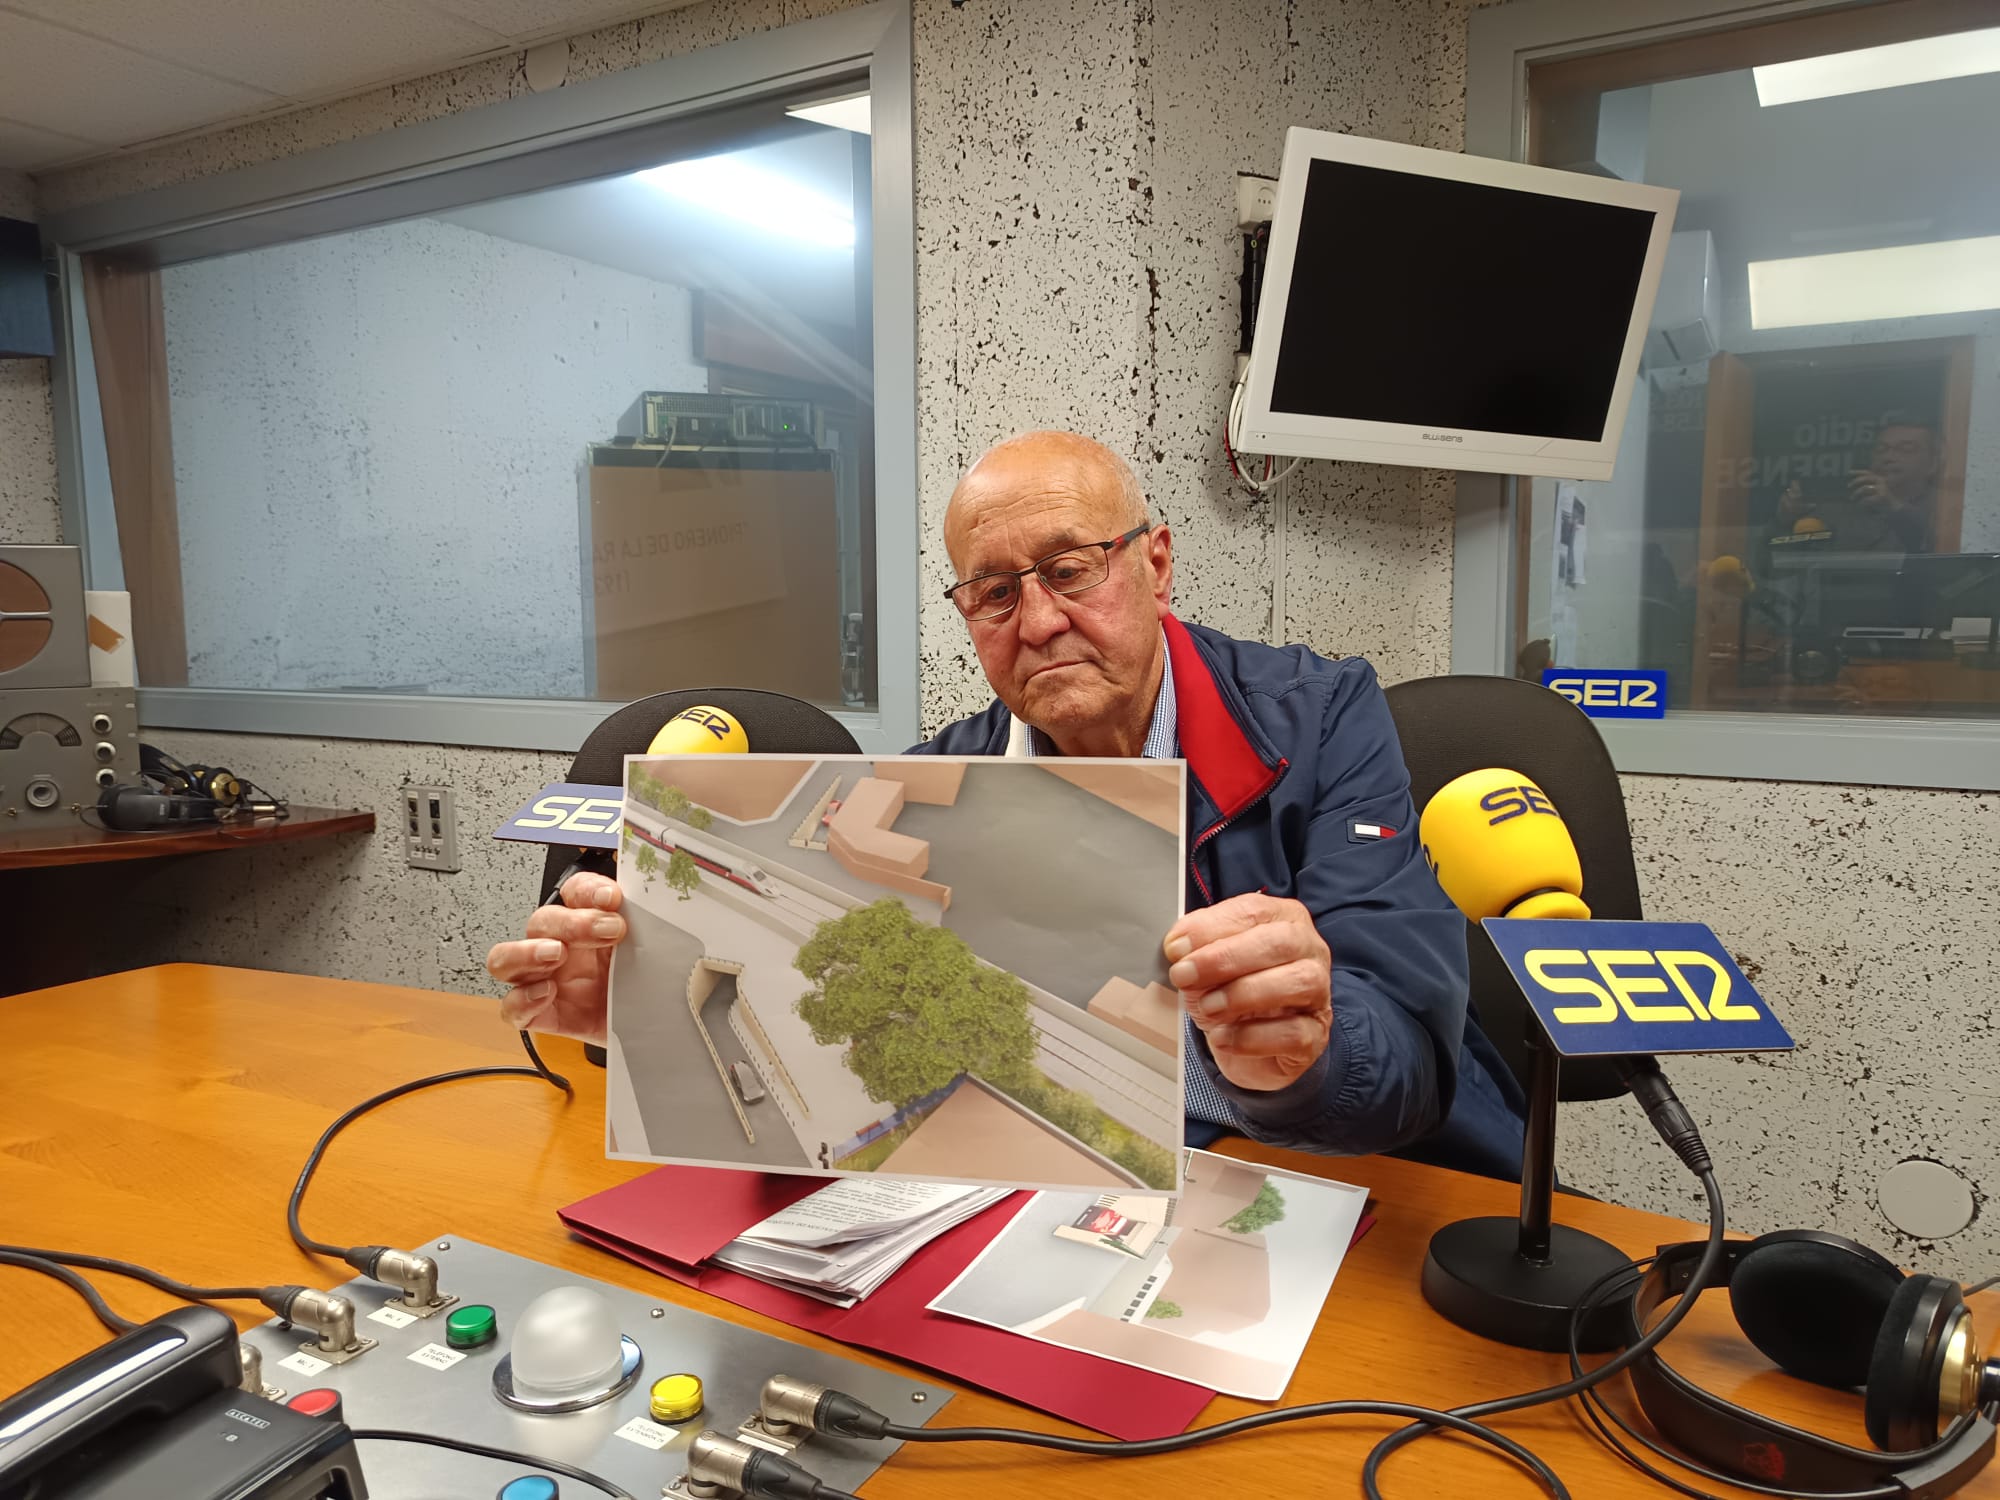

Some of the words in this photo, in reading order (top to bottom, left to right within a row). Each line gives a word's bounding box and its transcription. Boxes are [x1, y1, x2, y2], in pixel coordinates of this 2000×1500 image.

[1549, 678, 1658, 708] SER
[513, 795, 625, 834] SE
[1479, 784, 1560, 827] SE
[1523, 949, 1761, 1024] SER
